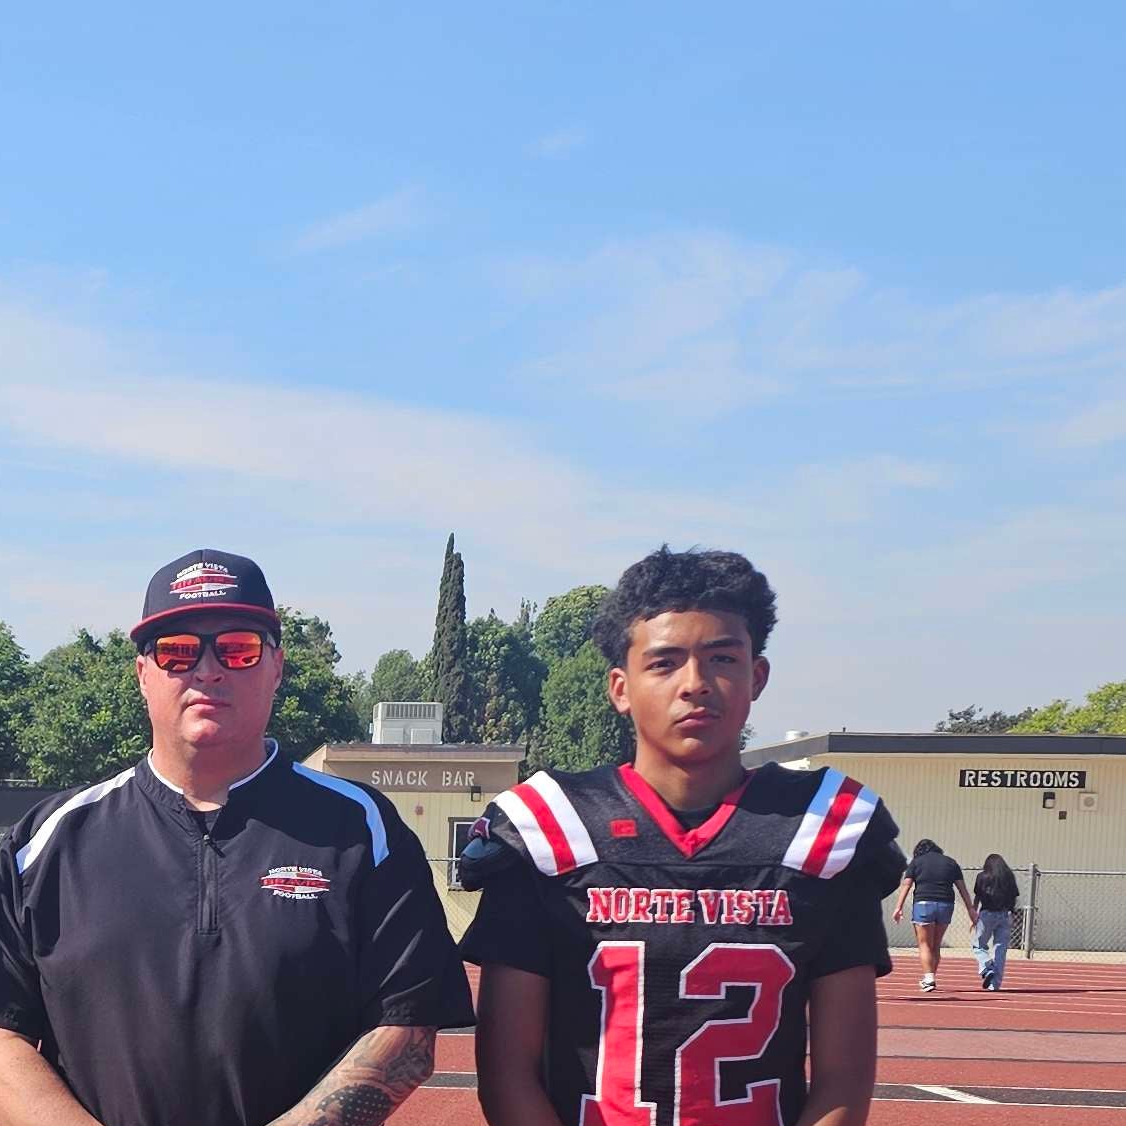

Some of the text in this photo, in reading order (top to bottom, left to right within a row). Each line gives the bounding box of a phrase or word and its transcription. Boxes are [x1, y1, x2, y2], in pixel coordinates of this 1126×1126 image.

[371, 770, 476, 787] SNACK BAR
[964, 770, 1080, 787] RESTROOMS
[586, 887, 794, 927] NORTE VISTA
